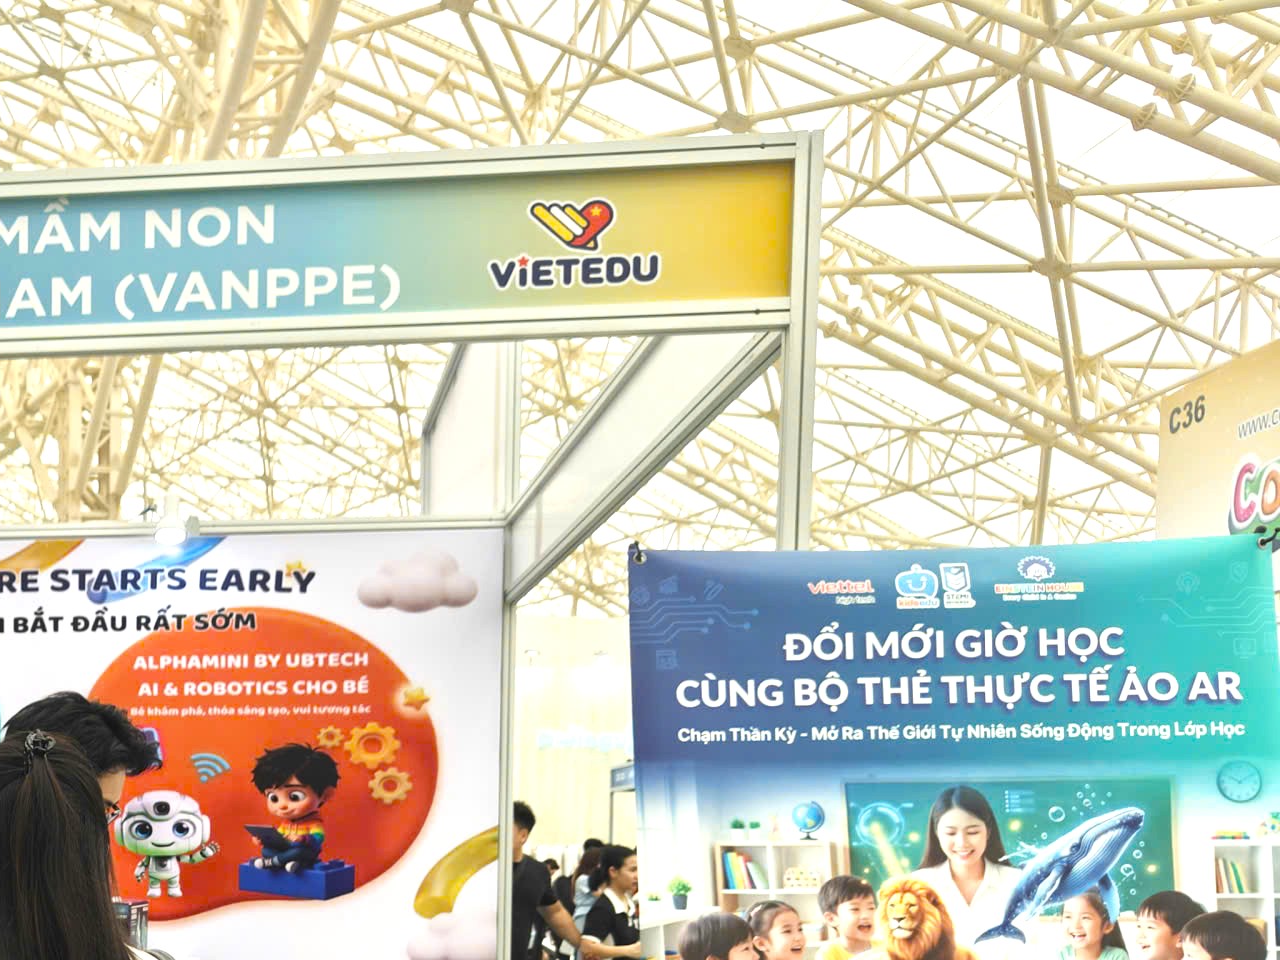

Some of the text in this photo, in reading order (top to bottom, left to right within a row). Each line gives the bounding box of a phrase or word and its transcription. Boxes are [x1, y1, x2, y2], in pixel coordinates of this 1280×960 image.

[145, 204, 276, 250] NON
[115, 263, 401, 320] (VANPPE)
[1169, 395, 1206, 434] C36
[51, 569, 186, 591] STARTS
[199, 569, 316, 594] EARLY
[14, 607, 63, 634] BẮT
[70, 606, 127, 632] ĐẦU
[137, 605, 187, 632] RẤT
[195, 606, 256, 631] SỚM
[783, 620, 1124, 667] ĐỔI MỚI GIỜ HỌC
[133, 652, 369, 670] ALPHAMINI BY UBTECH
[139, 675, 369, 696] AI & ROBOTICS CHO BÉ
[675, 664, 1243, 716] CÙNG BỘ THẺ THỰC TẾ ẢO AR
[678, 726, 726, 744] Chạm
[729, 724, 771, 742] Thần
[775, 726, 796, 744] Kỳ
[812, 726, 839, 741] Mở
[842, 726, 863, 740] Ra
[867, 724, 900, 740] Thế
[903, 723, 936, 740] Giới
[939, 724, 964, 742] Tự
[968, 723, 1017, 739] Nhiên
[1020, 722, 1065, 740] Sống
[1067, 721, 1114, 740] Động
[1117, 722, 1170, 740] Trong
[1174, 720, 1208, 739] Lớp
[1211, 720, 1246, 739] Học
